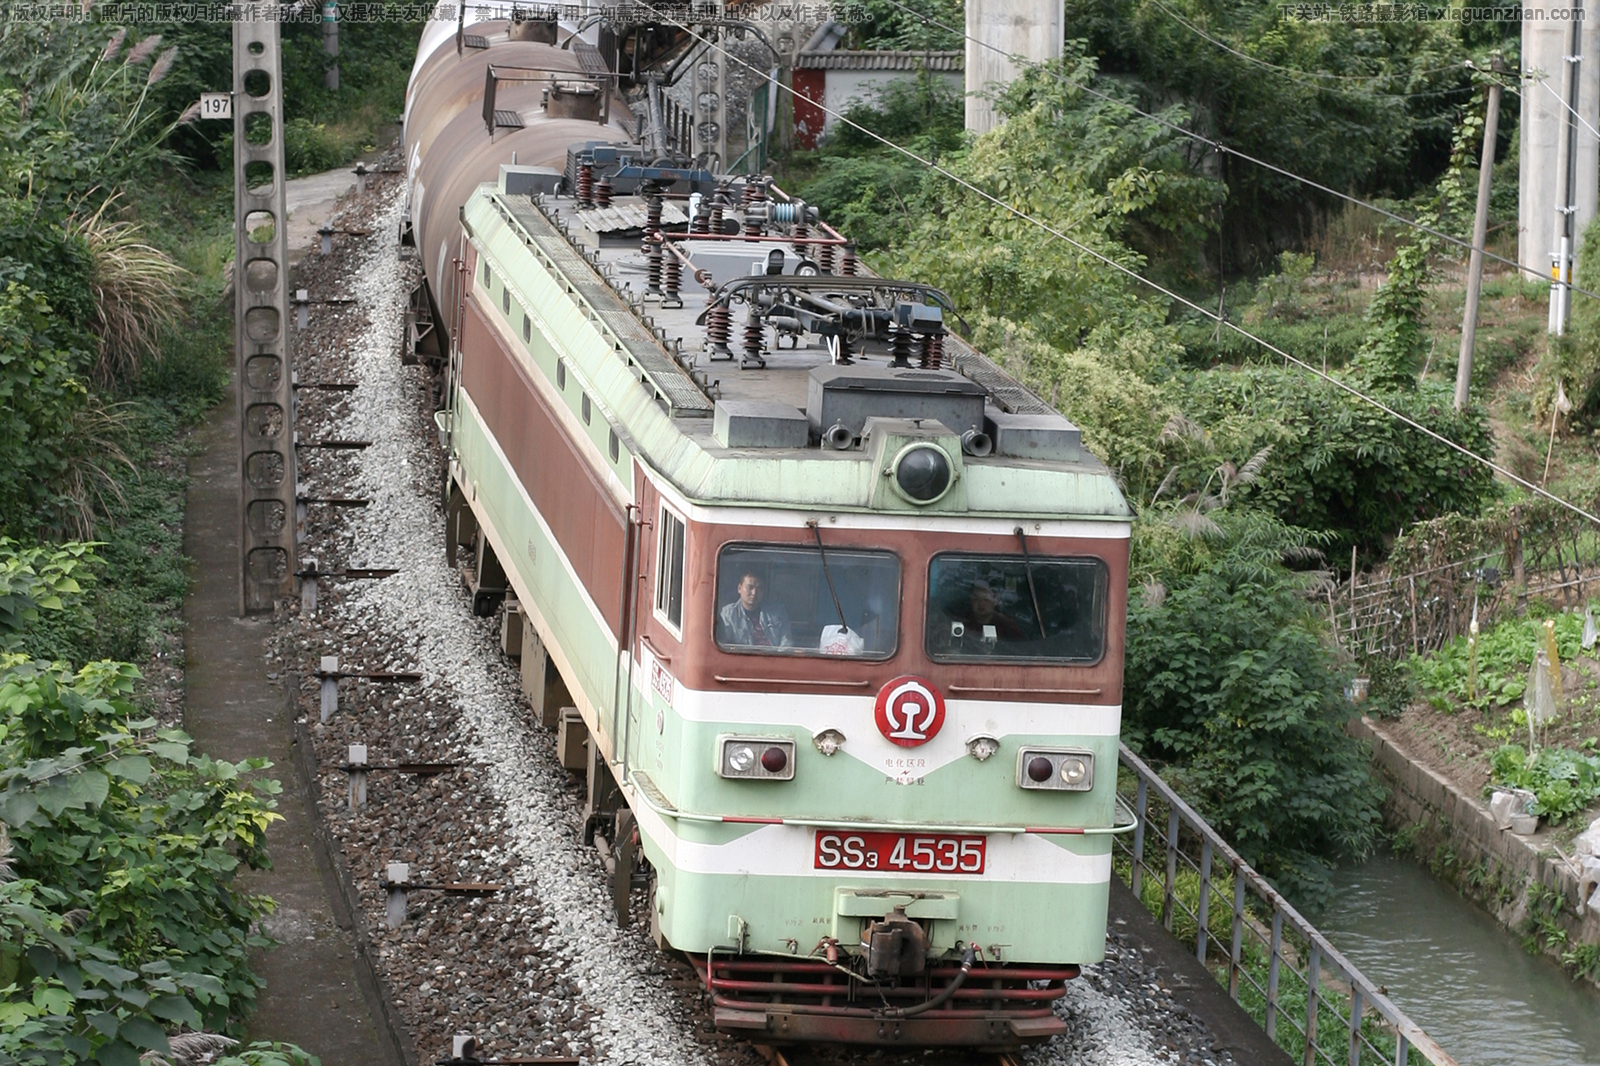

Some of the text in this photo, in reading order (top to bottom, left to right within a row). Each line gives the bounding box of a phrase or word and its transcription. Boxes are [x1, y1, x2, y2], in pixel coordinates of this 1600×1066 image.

[204, 98, 229, 113] 197
[885, 758, 925, 768] 电化区段
[819, 835, 983, 872] SS3 4535
